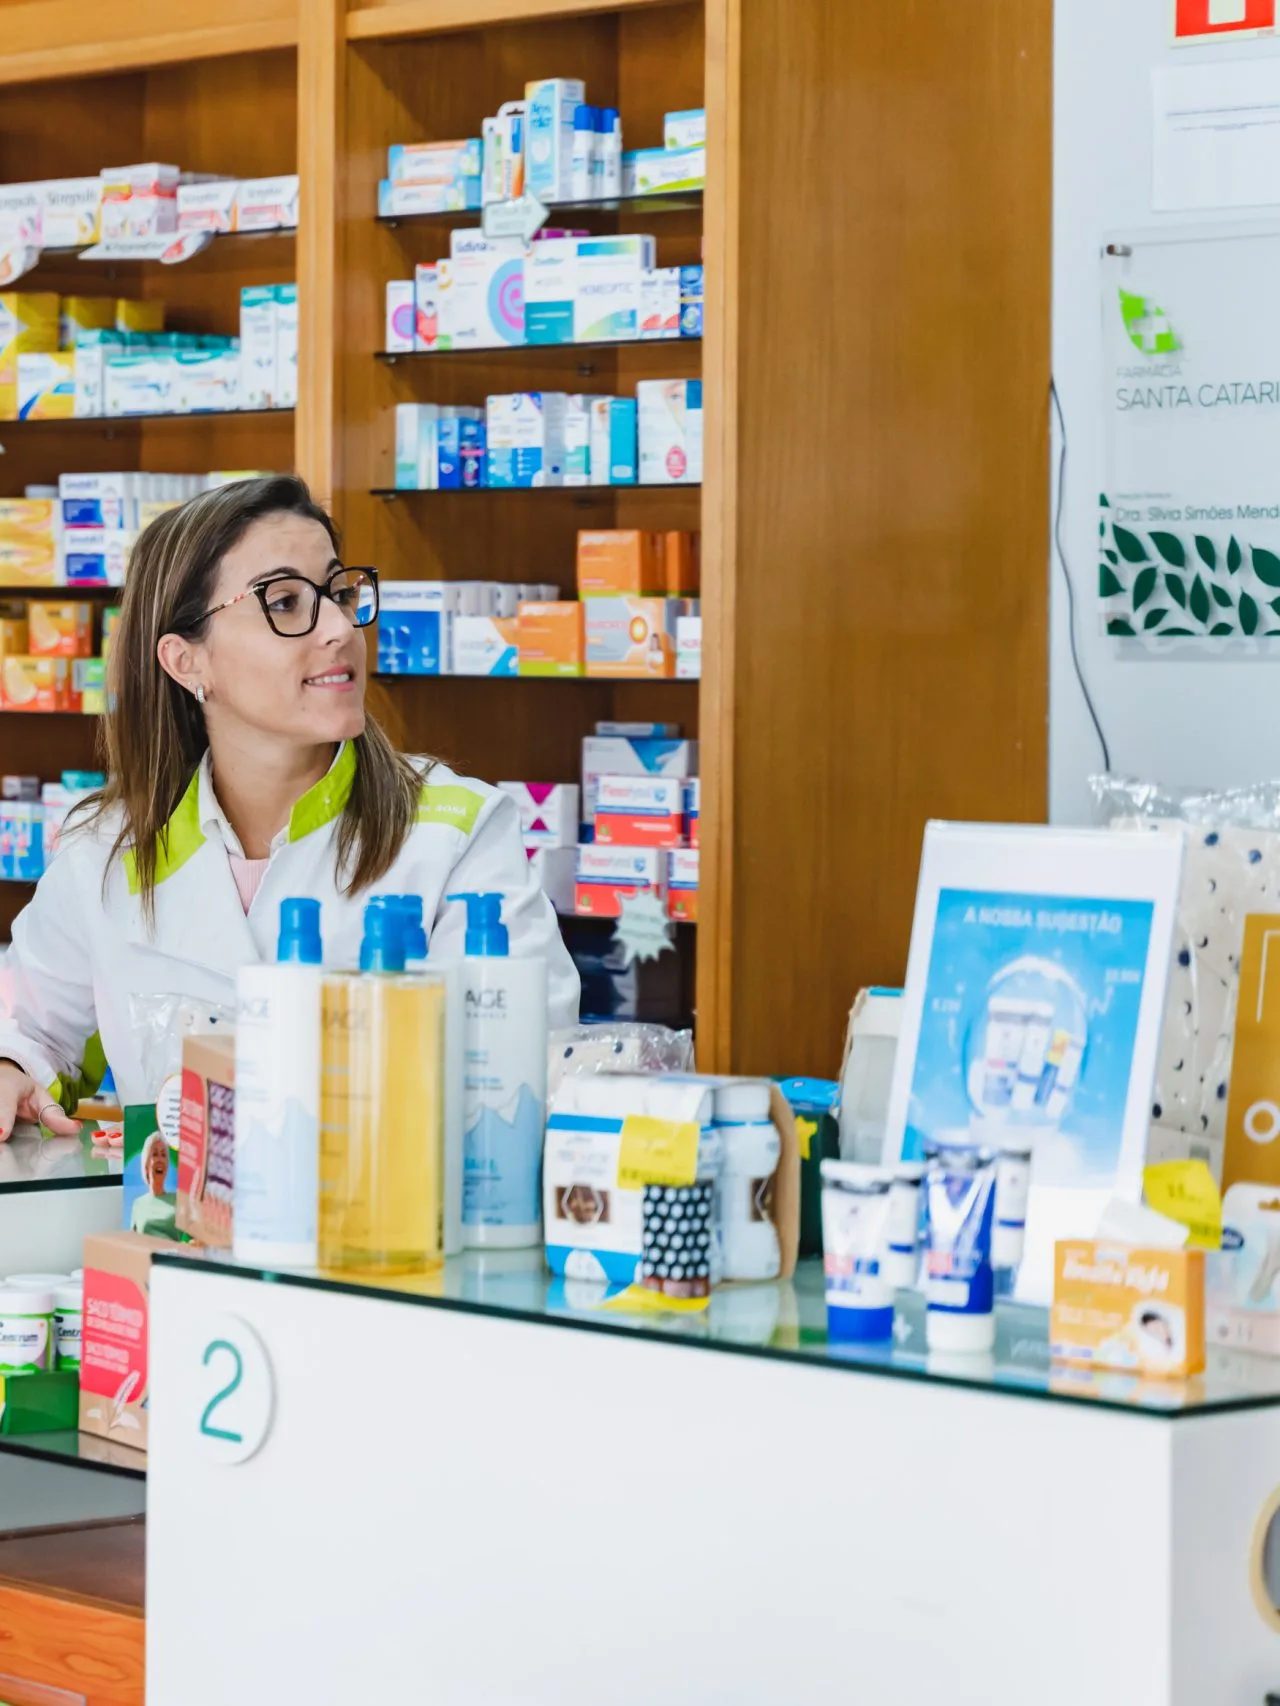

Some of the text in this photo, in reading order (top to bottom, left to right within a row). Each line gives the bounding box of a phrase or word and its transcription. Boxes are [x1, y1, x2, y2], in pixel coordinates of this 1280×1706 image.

[1116, 381, 1280, 411] SANTA CATARI
[1185, 504, 1234, 521] Simões
[1237, 504, 1280, 519] Mend
[963, 907, 978, 924] A
[57, 1326, 82, 1338] Centr
[200, 1339, 243, 1444] 2
